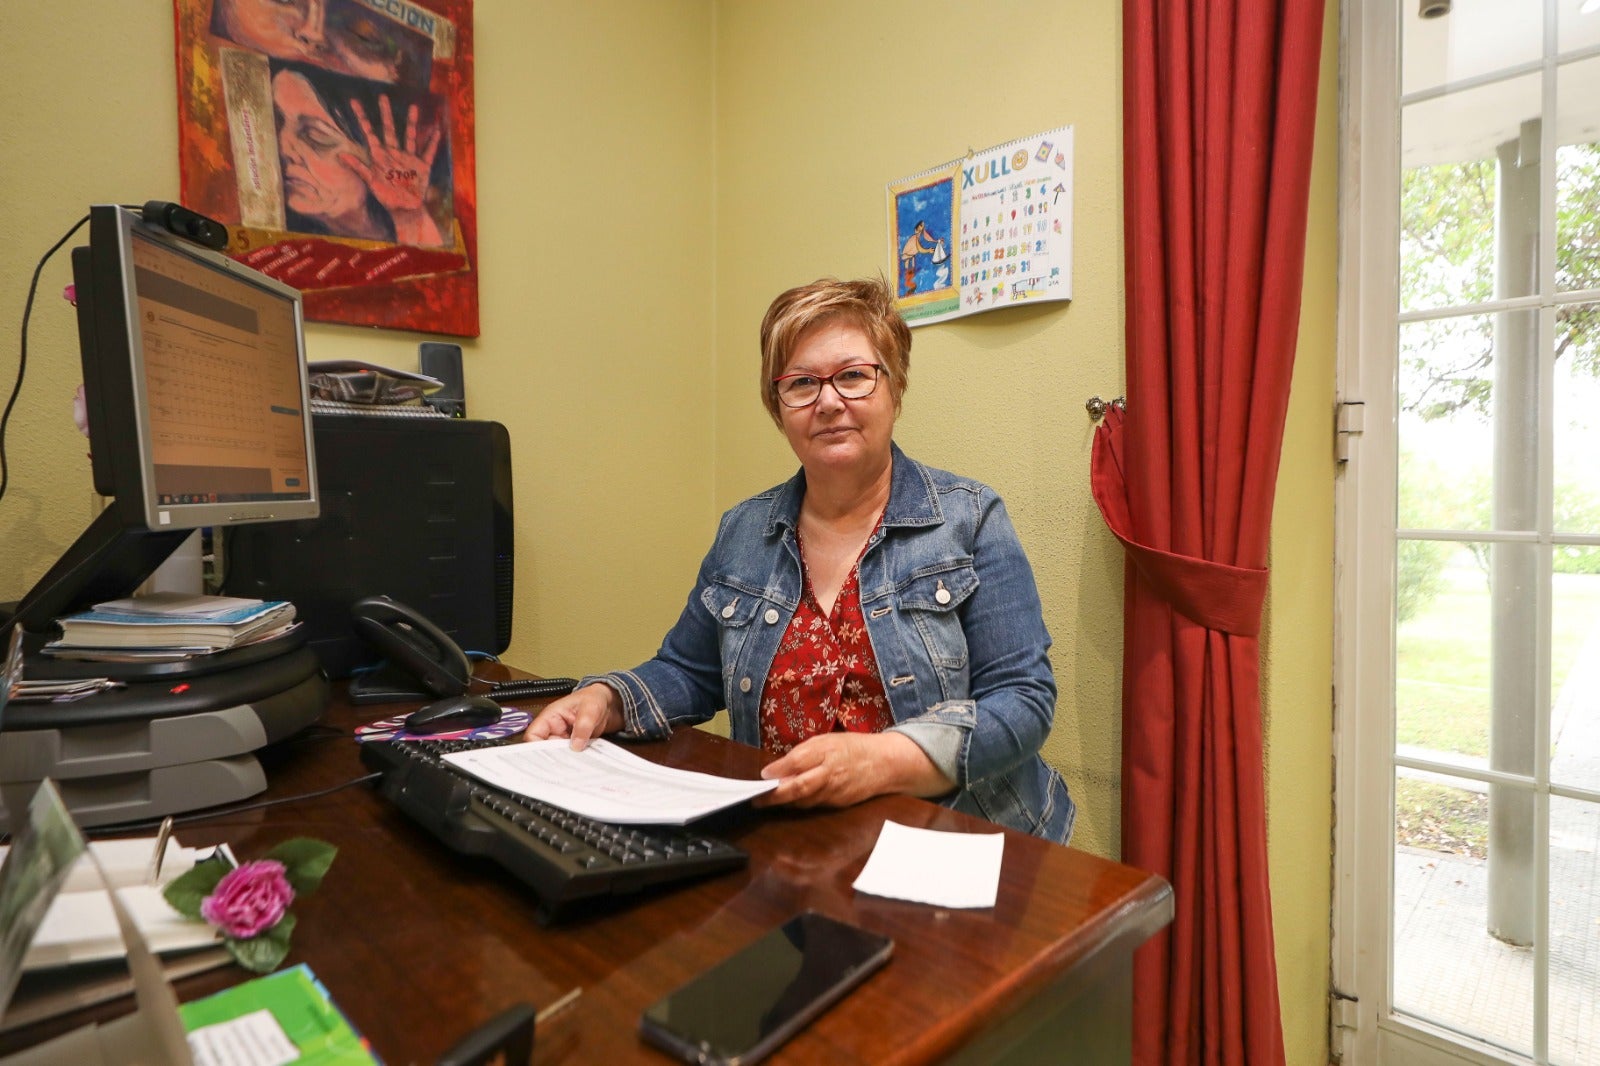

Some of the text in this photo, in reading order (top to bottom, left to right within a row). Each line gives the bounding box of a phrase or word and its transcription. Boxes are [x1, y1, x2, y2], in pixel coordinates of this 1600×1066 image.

[367, 0, 434, 34] CCION
[385, 169, 418, 181] STOP
[962, 149, 1028, 190] XULLO
